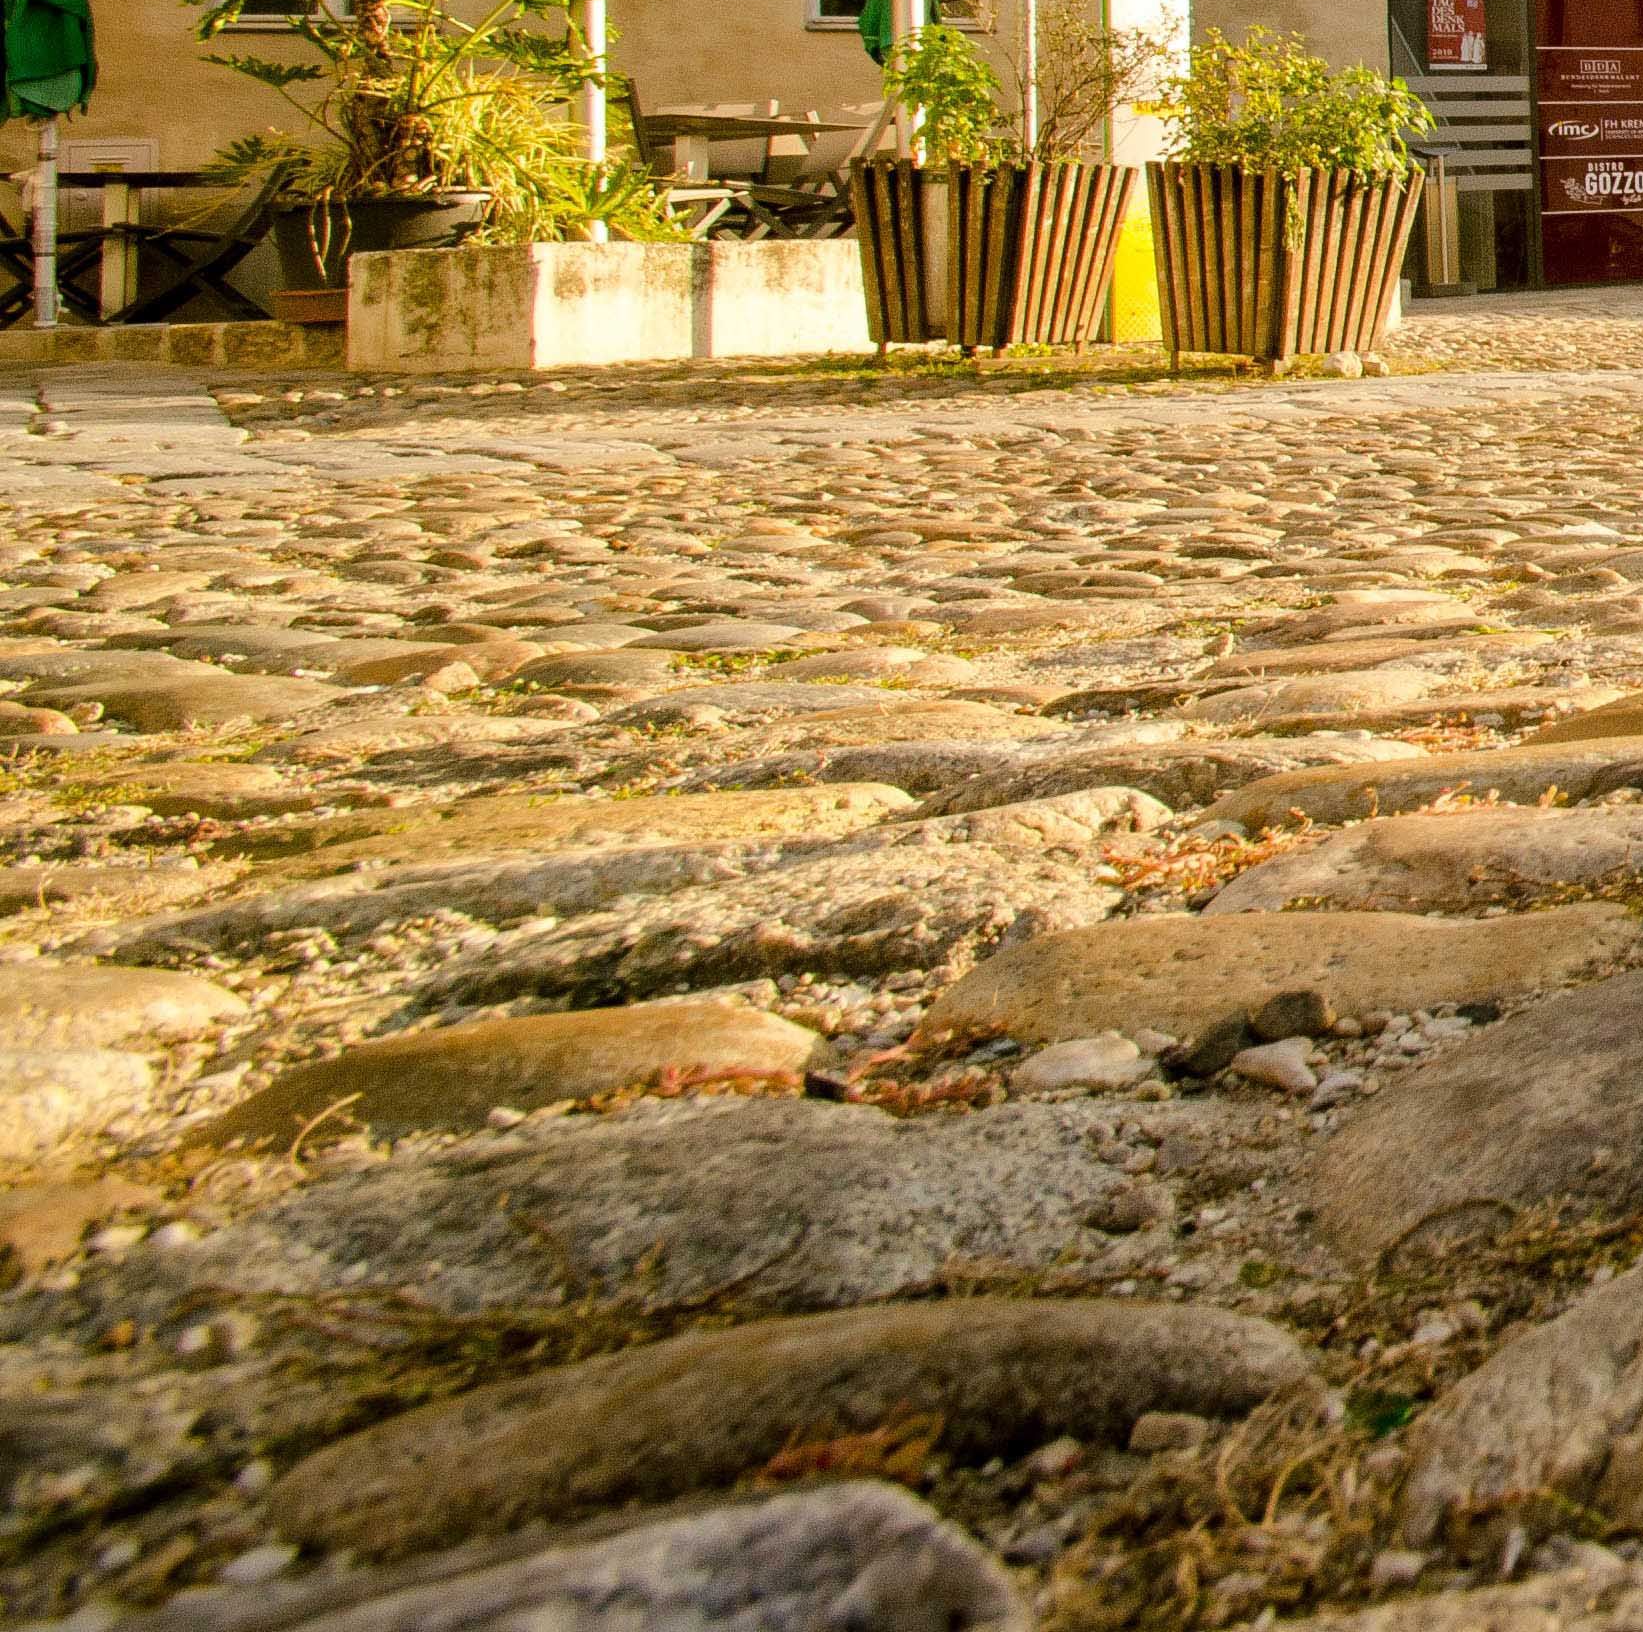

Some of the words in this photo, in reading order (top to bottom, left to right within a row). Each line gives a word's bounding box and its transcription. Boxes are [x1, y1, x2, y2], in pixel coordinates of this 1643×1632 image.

[1431, 6, 1455, 16] DES
[1431, 15, 1464, 24] DENK
[1431, 23, 1465, 33] MALS
[1583, 62, 1618, 72] BDA
[1604, 119, 1618, 129] FH
[1588, 161, 1624, 172] BISTRO
